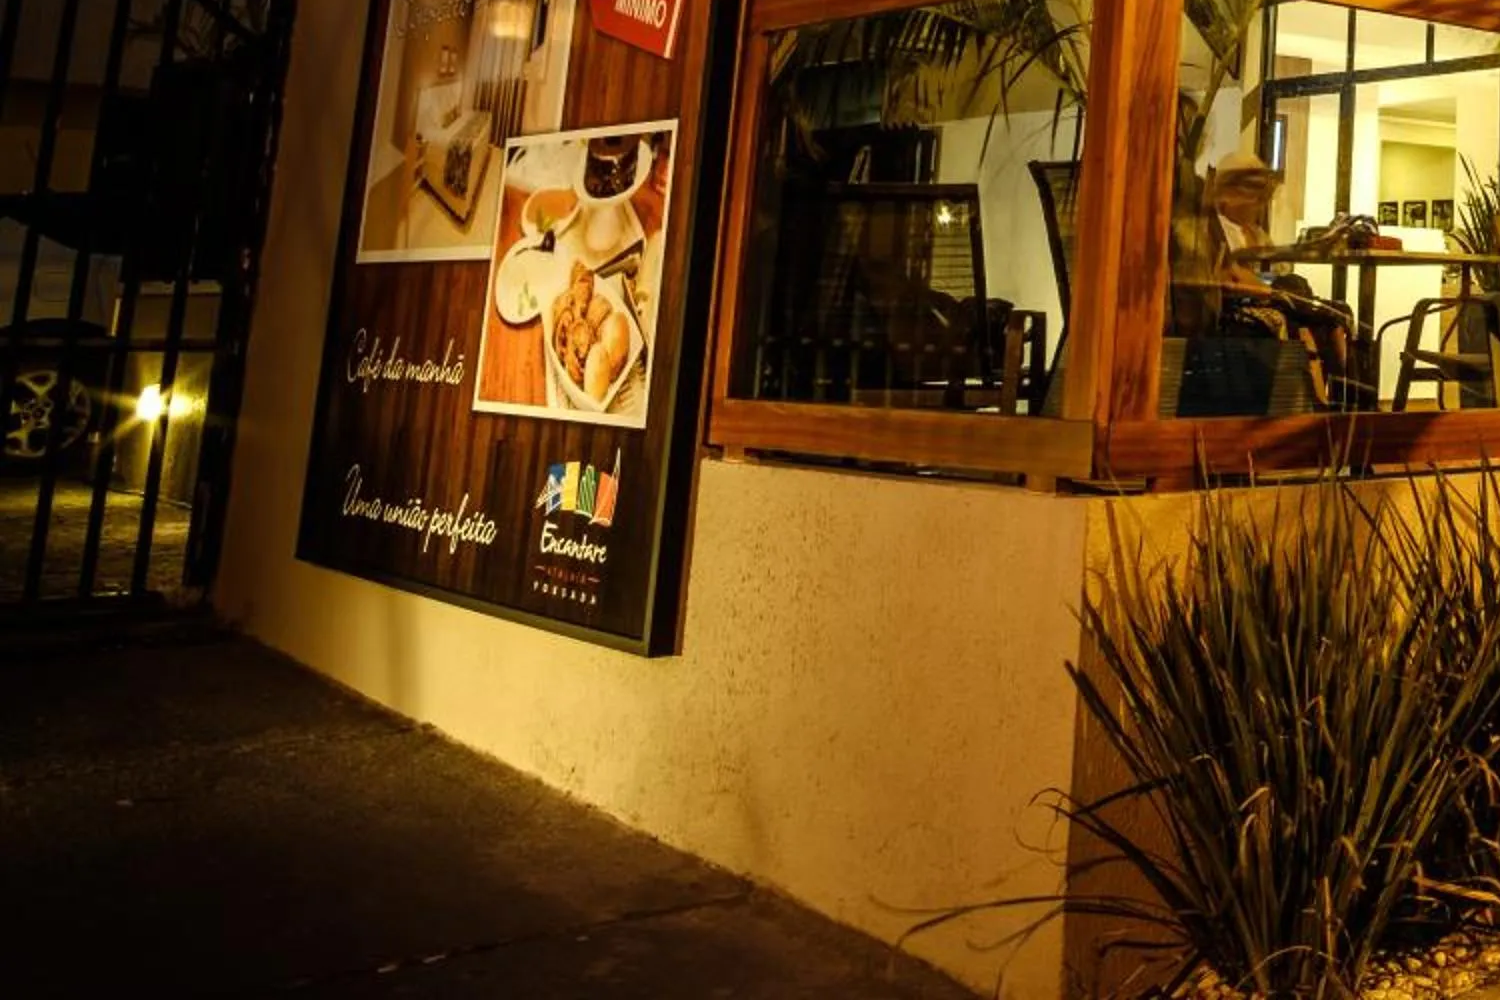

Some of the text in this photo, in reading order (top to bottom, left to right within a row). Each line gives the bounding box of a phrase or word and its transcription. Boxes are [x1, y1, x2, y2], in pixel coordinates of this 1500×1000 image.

[347, 327, 464, 393] Café da manhã
[343, 463, 498, 555] Uma união perfeita
[541, 520, 607, 564] Encantare
